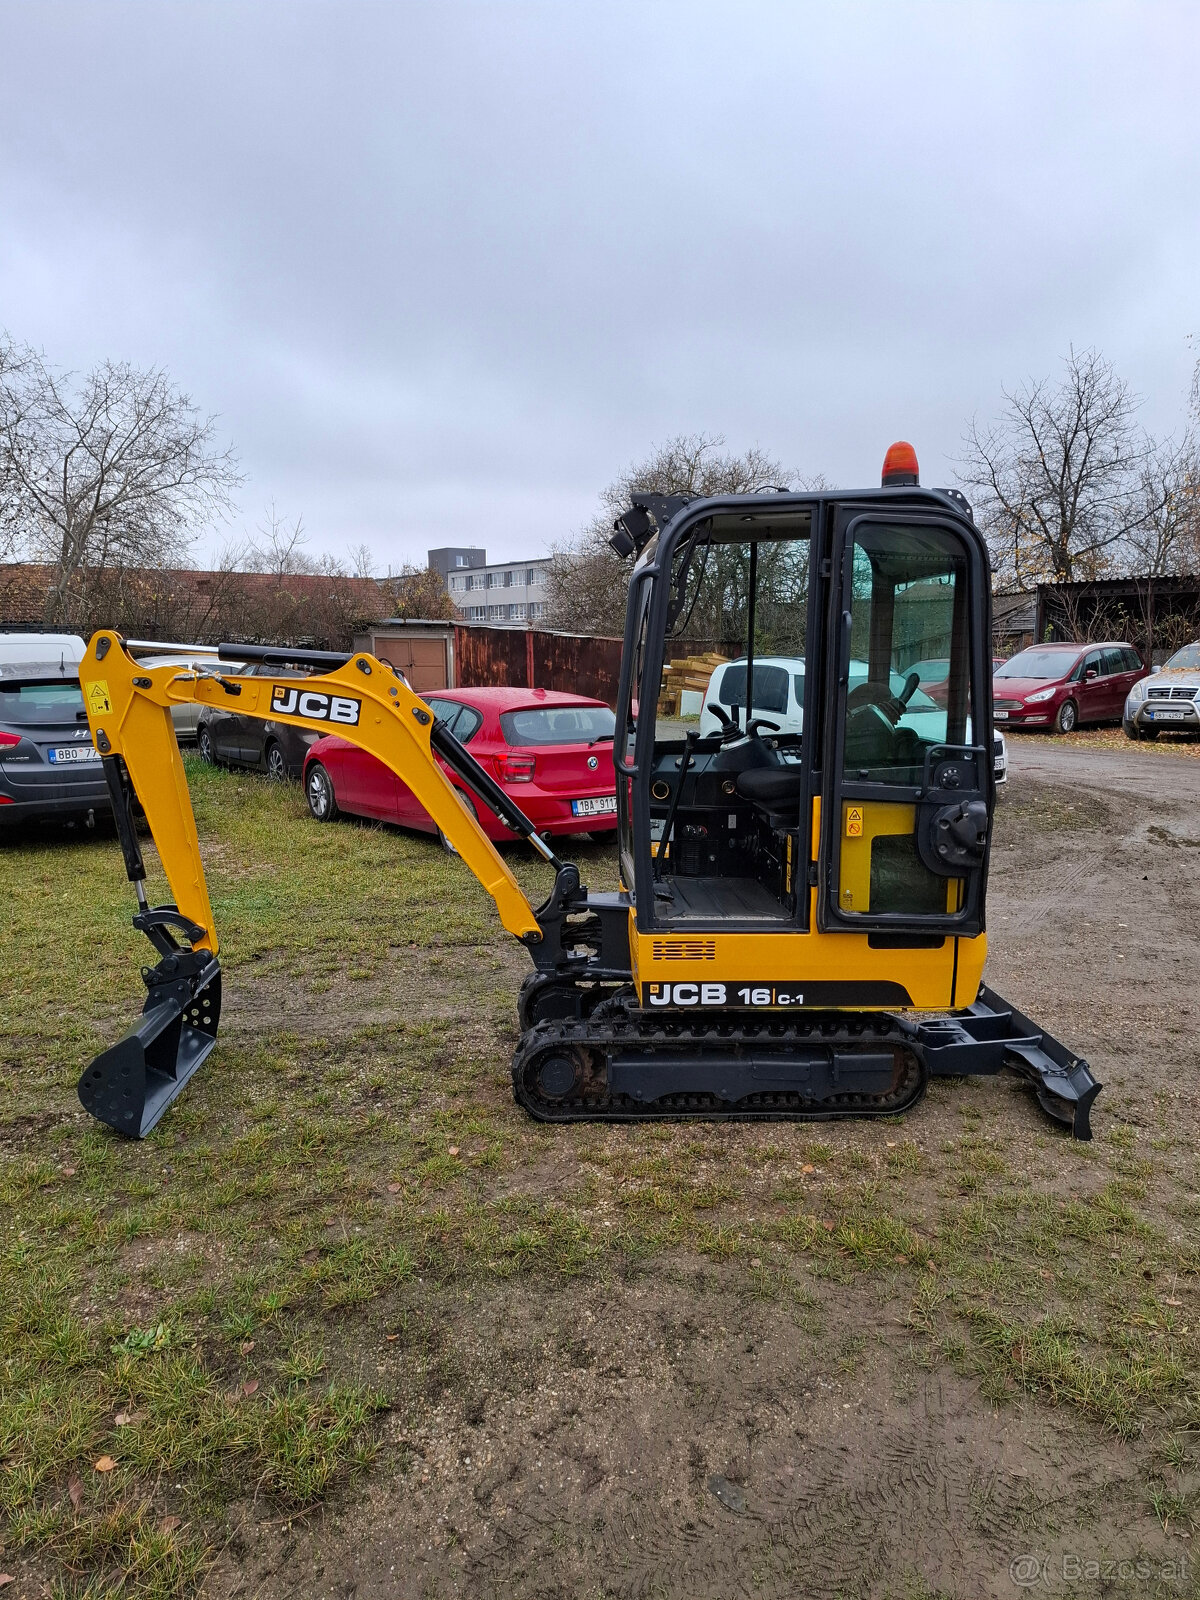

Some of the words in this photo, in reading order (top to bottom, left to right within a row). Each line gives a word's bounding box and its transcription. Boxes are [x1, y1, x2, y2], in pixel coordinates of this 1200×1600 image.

[273, 690, 359, 723] JCB
[579, 799, 595, 811] 1BA
[650, 984, 726, 1005] JCB
[738, 988, 771, 1005] 16
